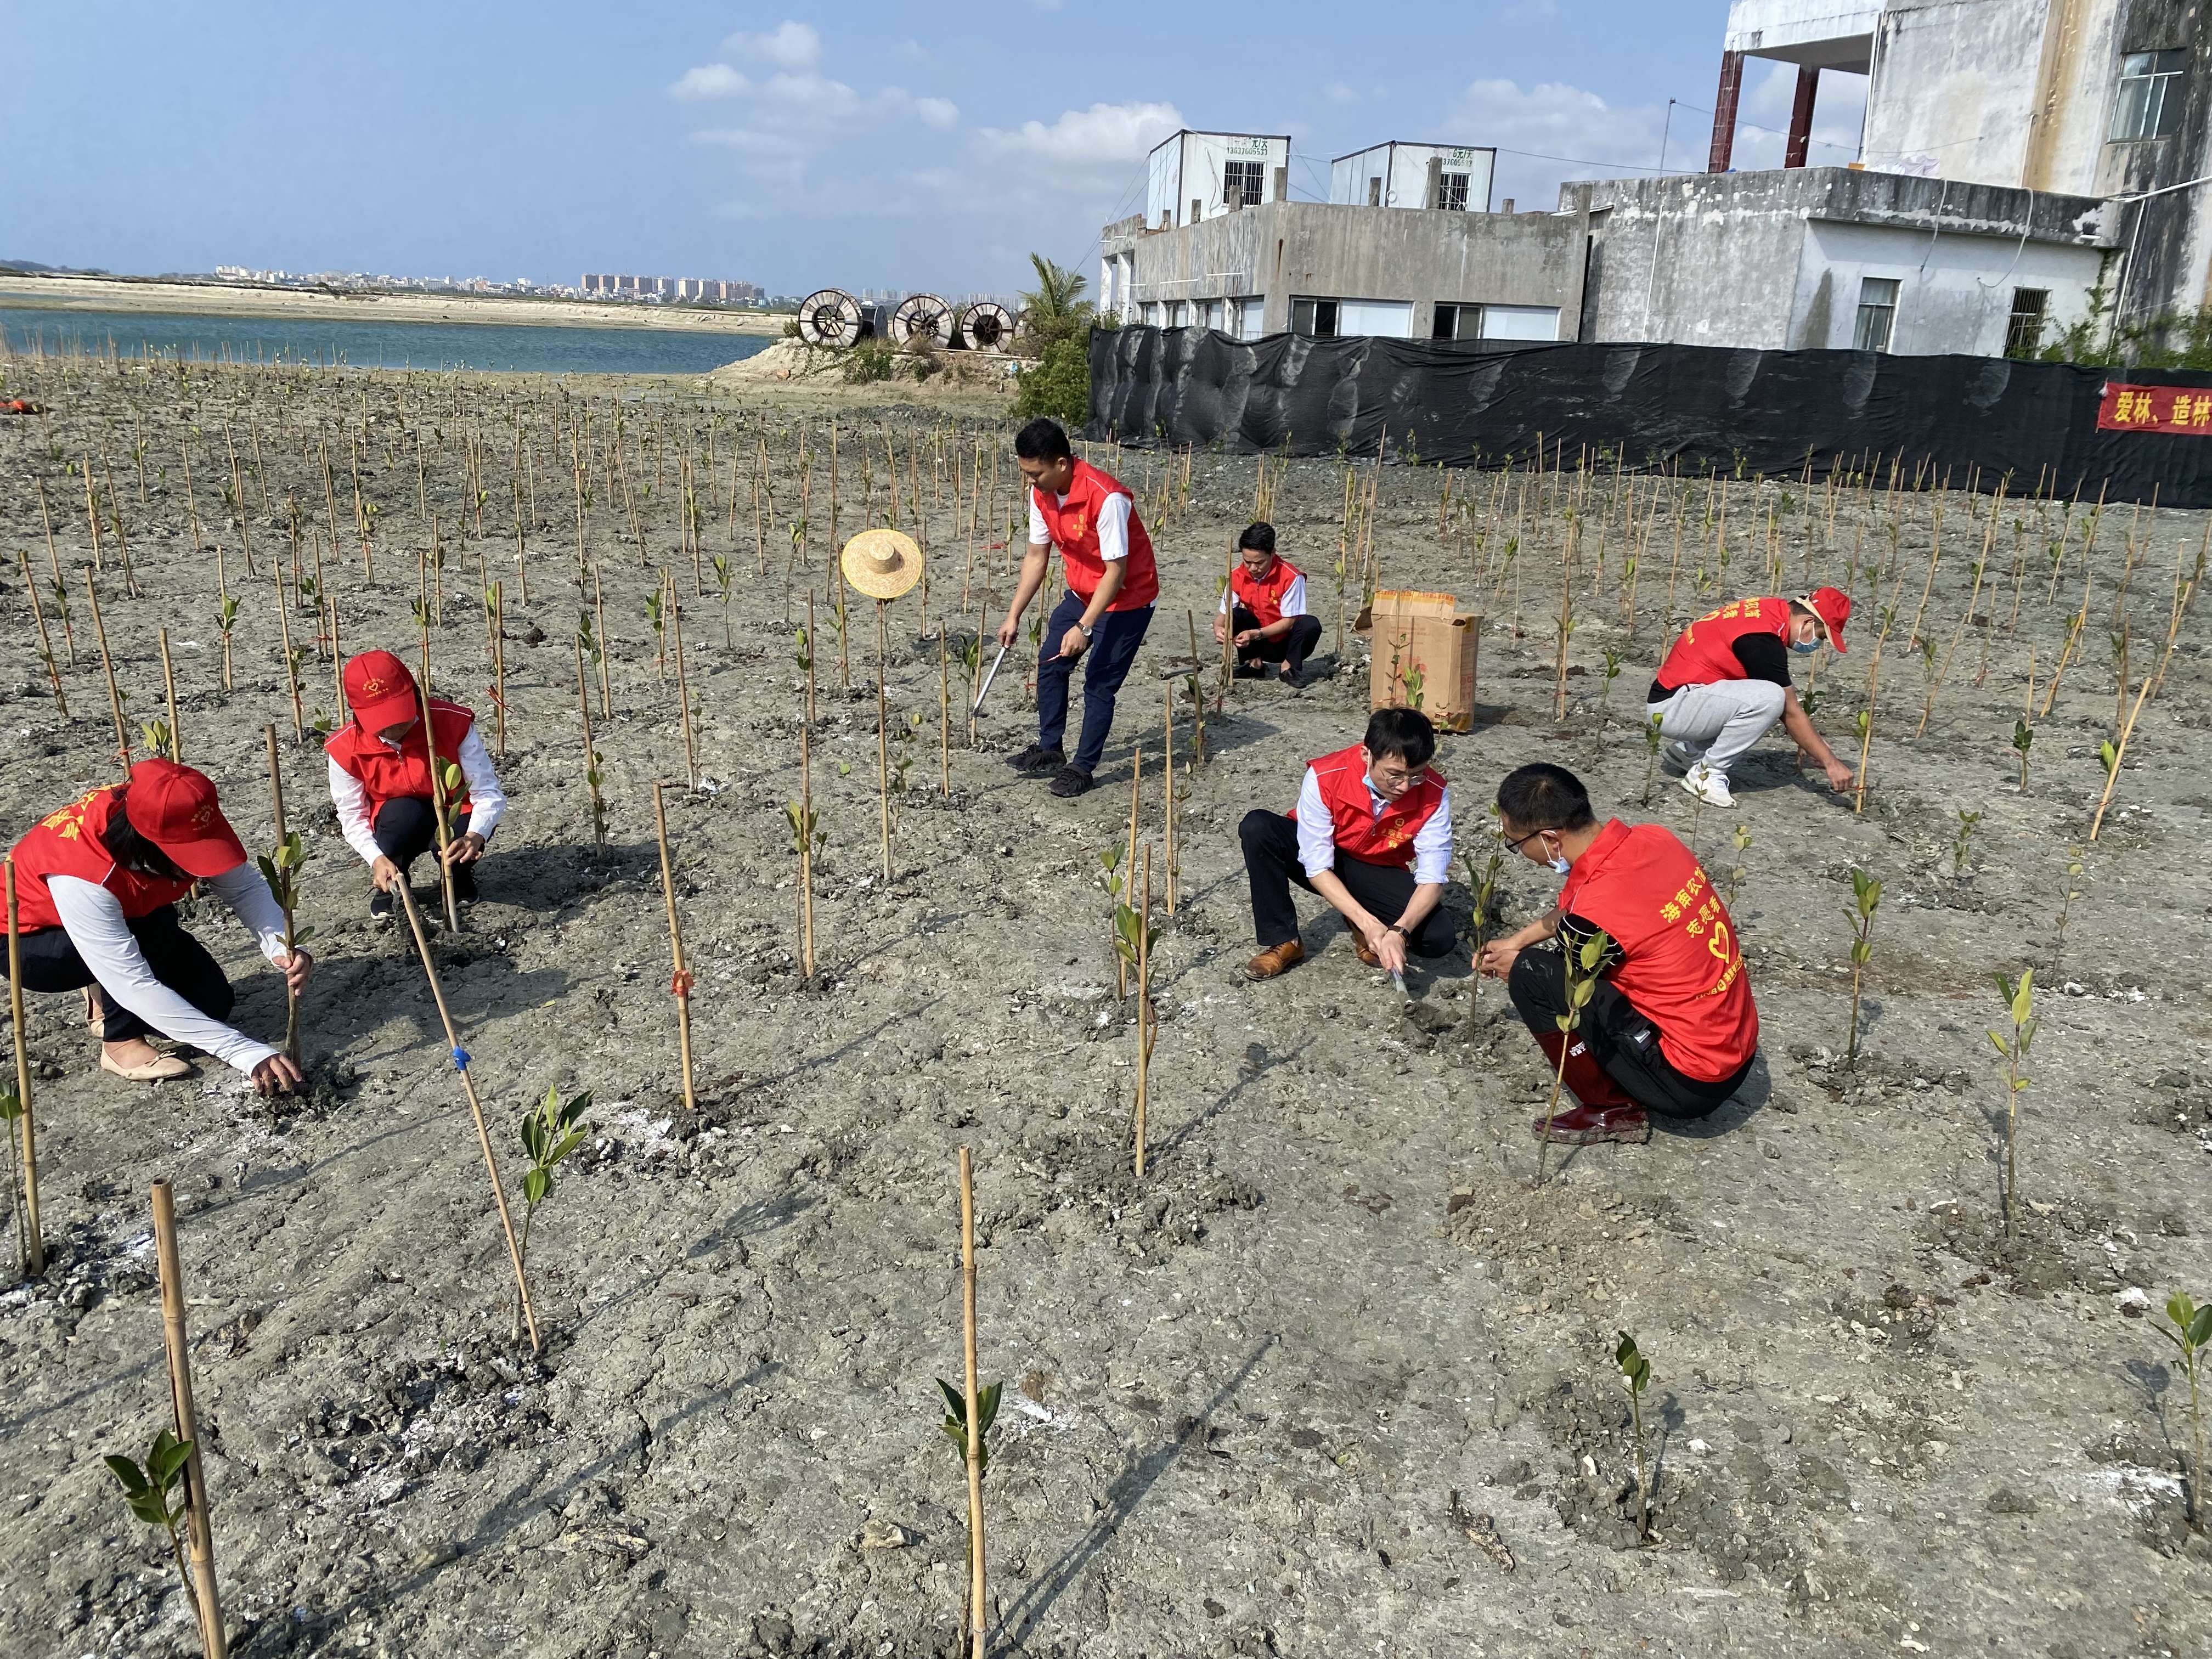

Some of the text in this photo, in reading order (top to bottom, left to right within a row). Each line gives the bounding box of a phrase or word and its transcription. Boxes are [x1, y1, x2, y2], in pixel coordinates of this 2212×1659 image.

[1660, 866, 1706, 923] 海南农信
[1685, 895, 1720, 938] 志愿者
